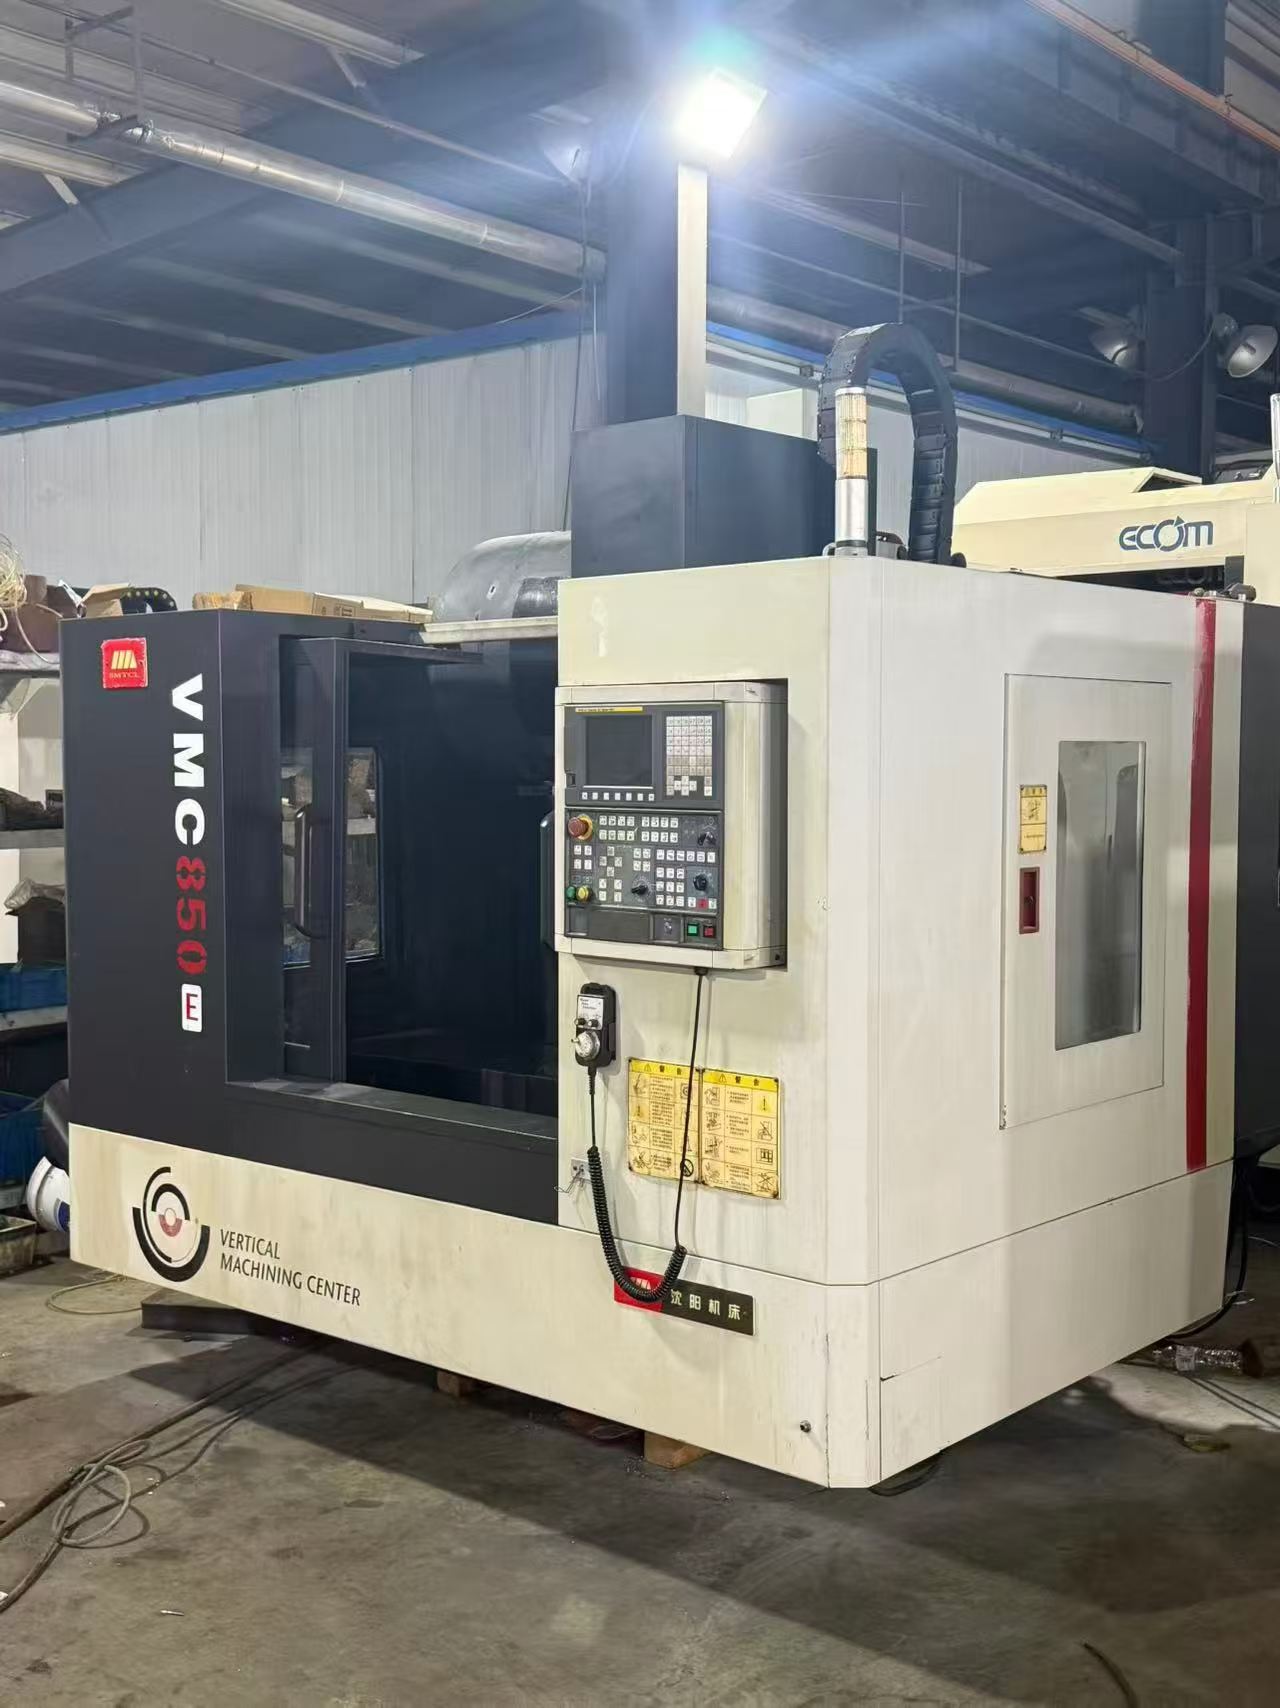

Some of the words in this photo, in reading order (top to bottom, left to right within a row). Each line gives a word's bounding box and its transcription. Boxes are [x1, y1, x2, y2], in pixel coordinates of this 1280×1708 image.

[220, 1228, 281, 1260] VERTICAL
[220, 1252, 302, 1290] MACHINING
[306, 1274, 361, 1306] CENTER
